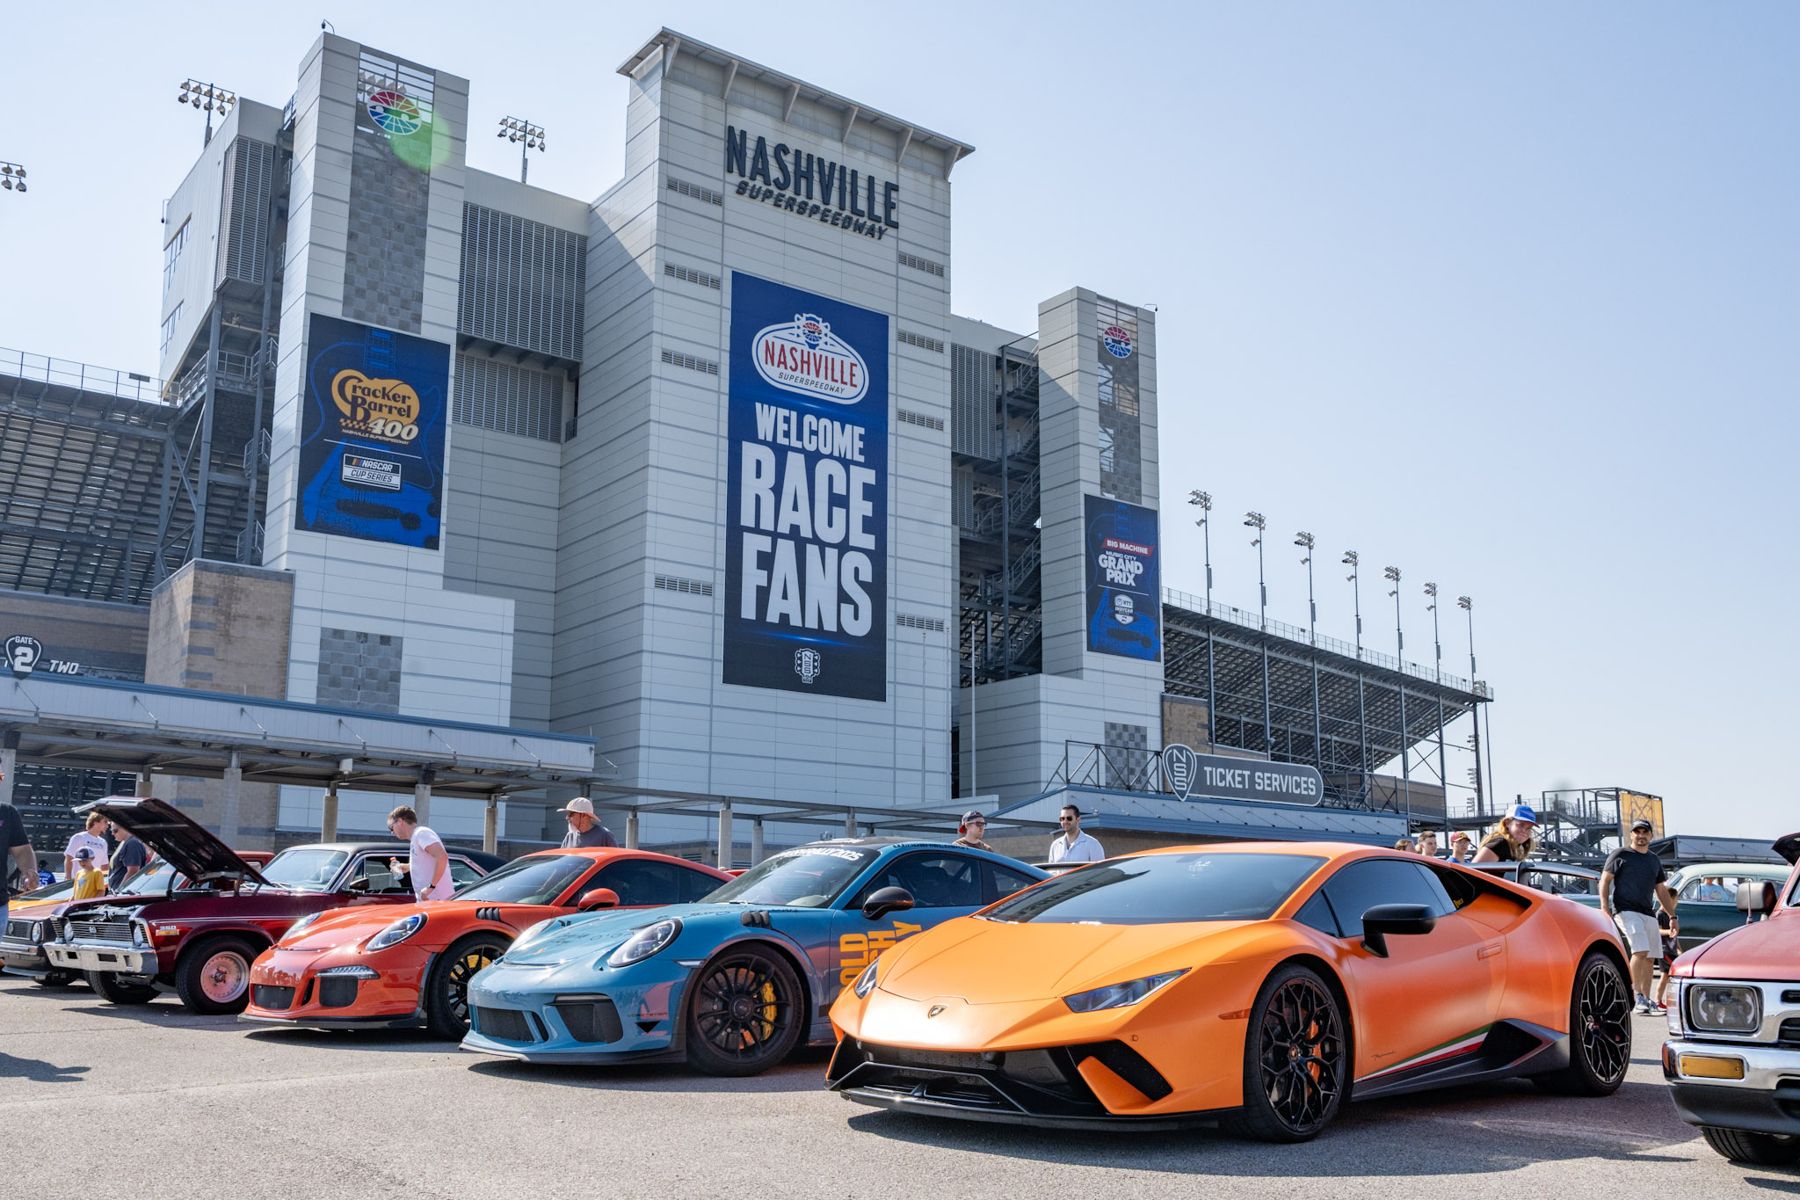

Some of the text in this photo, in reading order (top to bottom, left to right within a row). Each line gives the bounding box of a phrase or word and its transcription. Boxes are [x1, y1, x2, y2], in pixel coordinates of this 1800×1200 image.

[727, 125, 899, 229] NASHVILLE
[735, 180, 889, 240] SUPERSPEEDWAY
[764, 339, 858, 388] NASHVILLE
[337, 375, 412, 405] Cracker
[778, 372, 846, 395] SUPERSPEEDWAY
[350, 394, 412, 421] Barrel
[368, 417, 419, 441] 400
[755, 402, 865, 463] WELCOME
[350, 469, 393, 483] CUP SERIES
[361, 459, 393, 471] NASCAR
[740, 440, 876, 550] RACE
[1106, 539, 1149, 554] BIG MACHINE
[1098, 553, 1144, 575] GRAND
[1106, 568, 1136, 587] PRIX
[740, 531, 873, 637] FANS
[15, 636, 33, 645] GATE
[13, 646, 34, 673] 2
[49, 659, 79, 675] TWO
[1173, 749, 1187, 791] NSS
[1204, 766, 1316, 796] TICKET SERVICES
[839, 933, 869, 993] OLD
